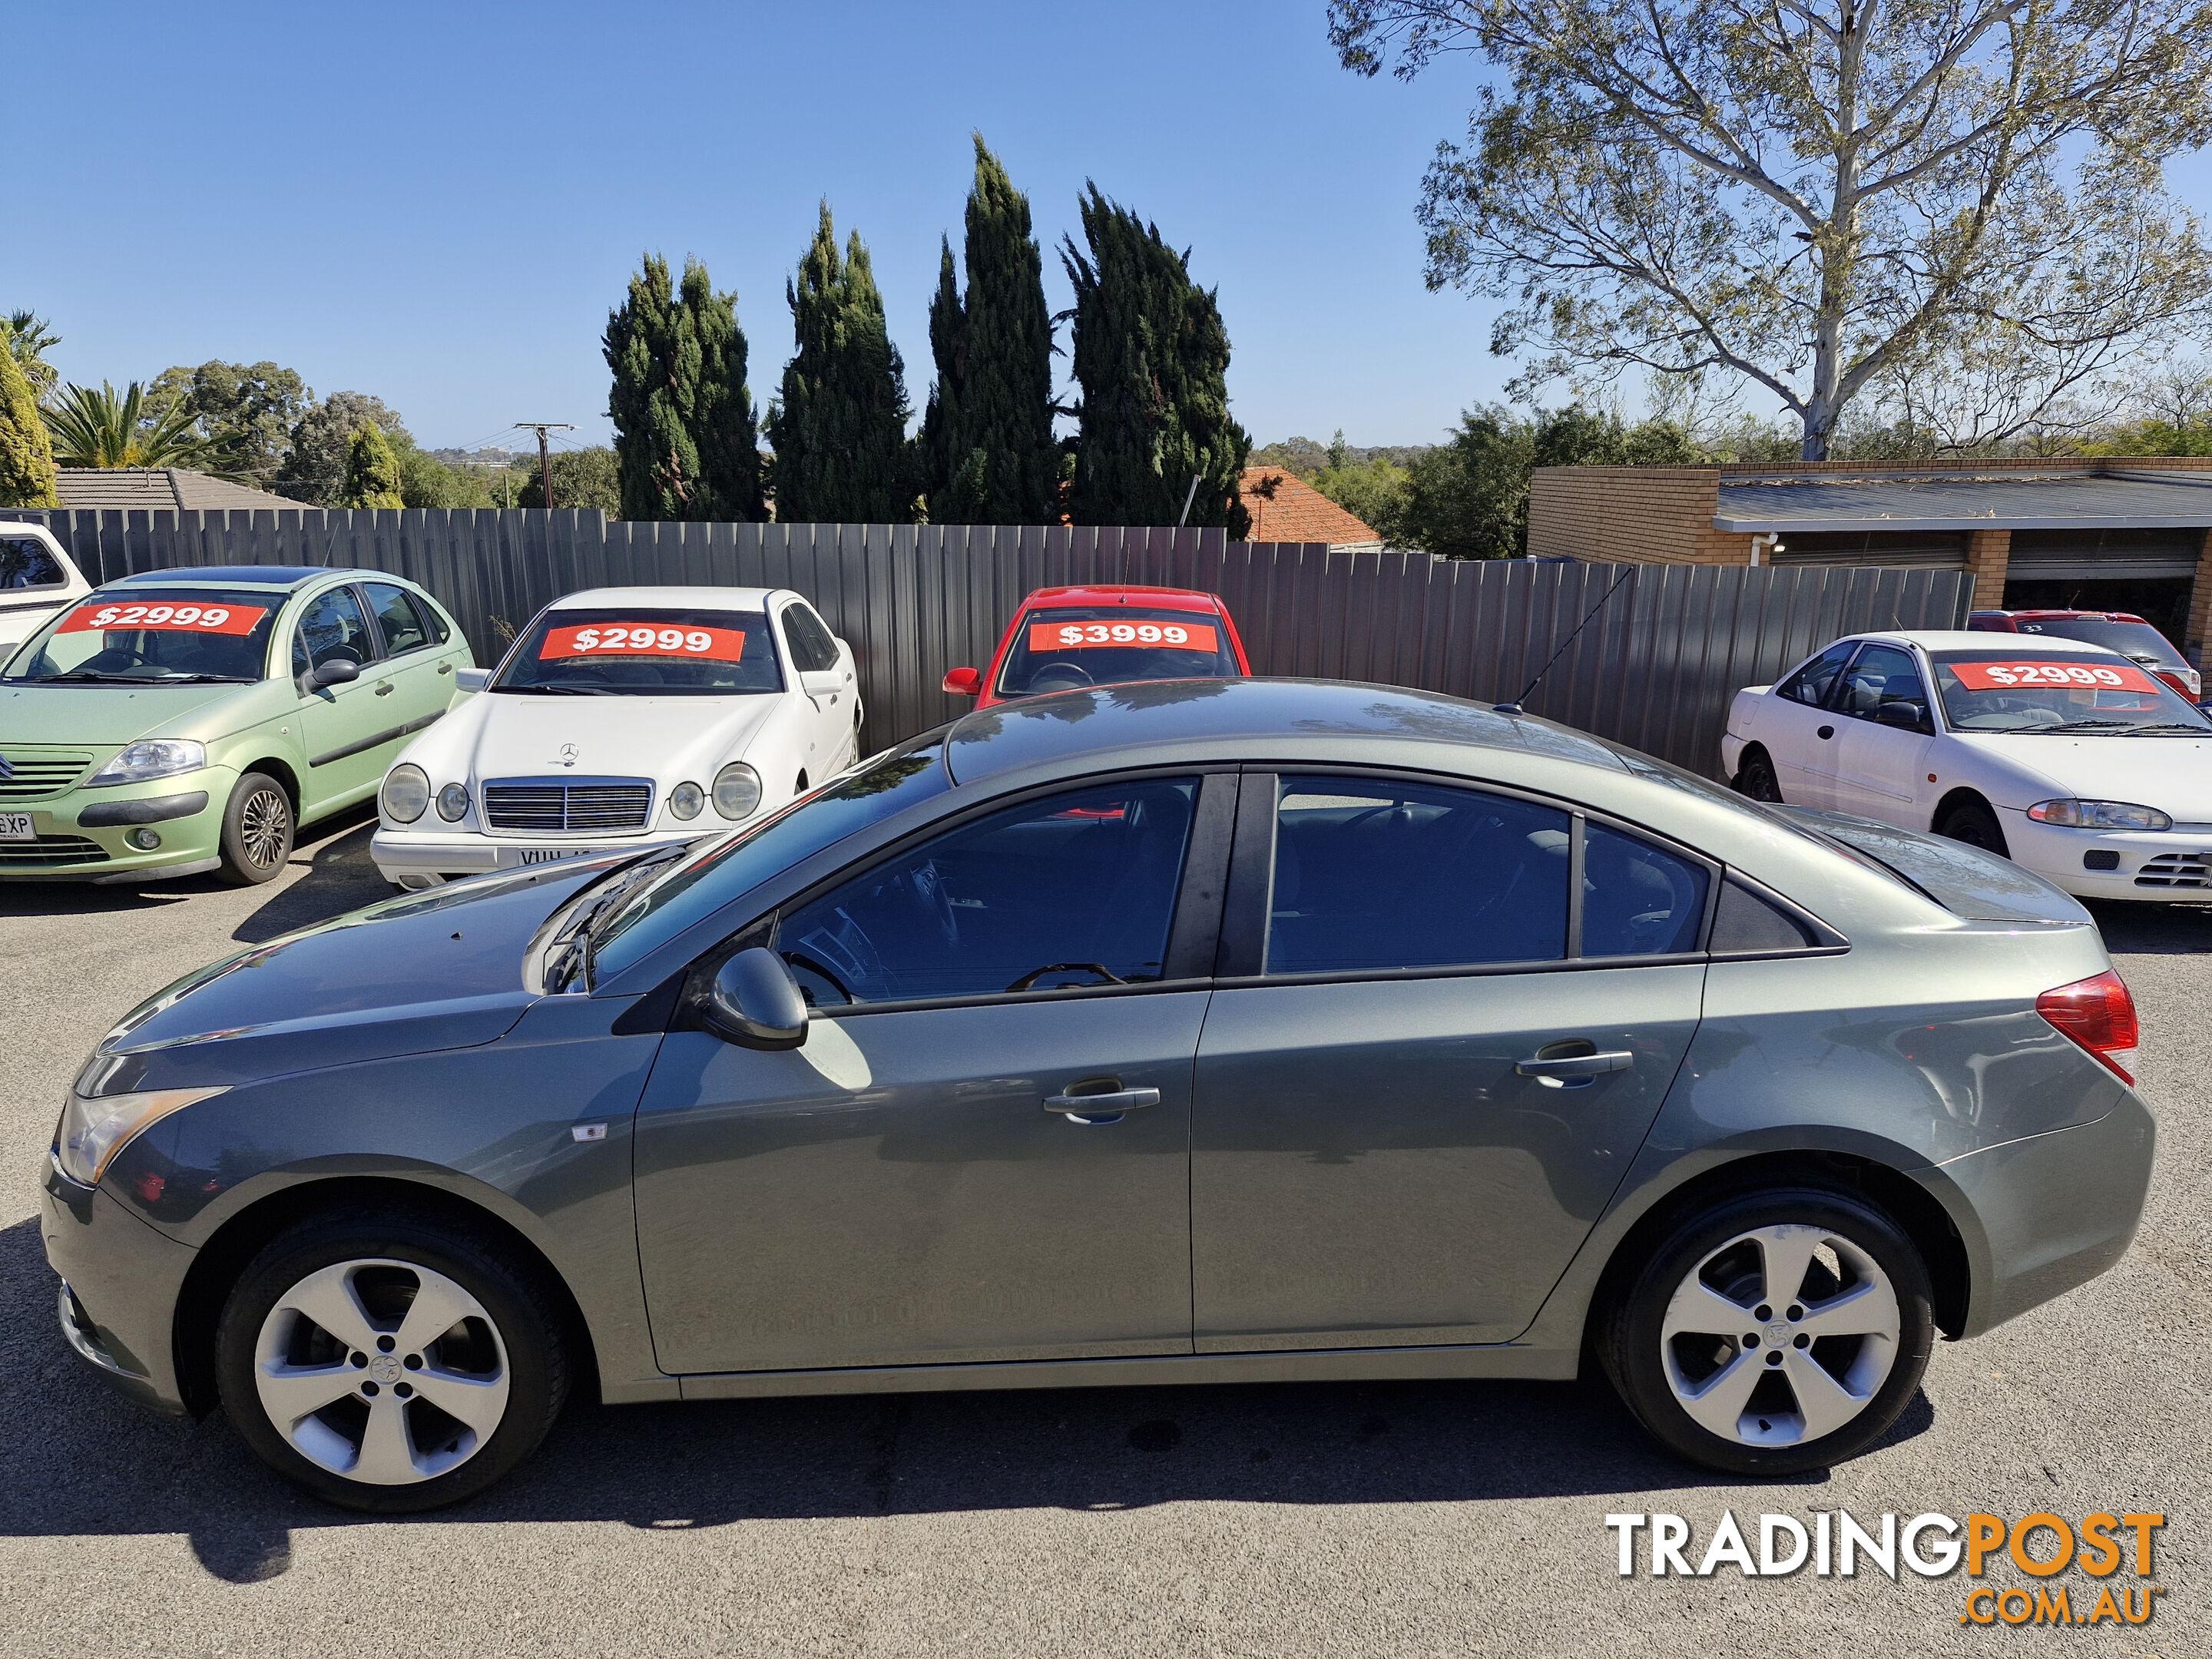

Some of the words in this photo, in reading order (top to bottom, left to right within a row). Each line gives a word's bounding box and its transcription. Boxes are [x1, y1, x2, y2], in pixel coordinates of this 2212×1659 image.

[89, 606, 230, 628] $2999
[573, 628, 712, 652] $2999
[1059, 624, 1188, 646] $3999
[1986, 664, 2123, 686] $2999
